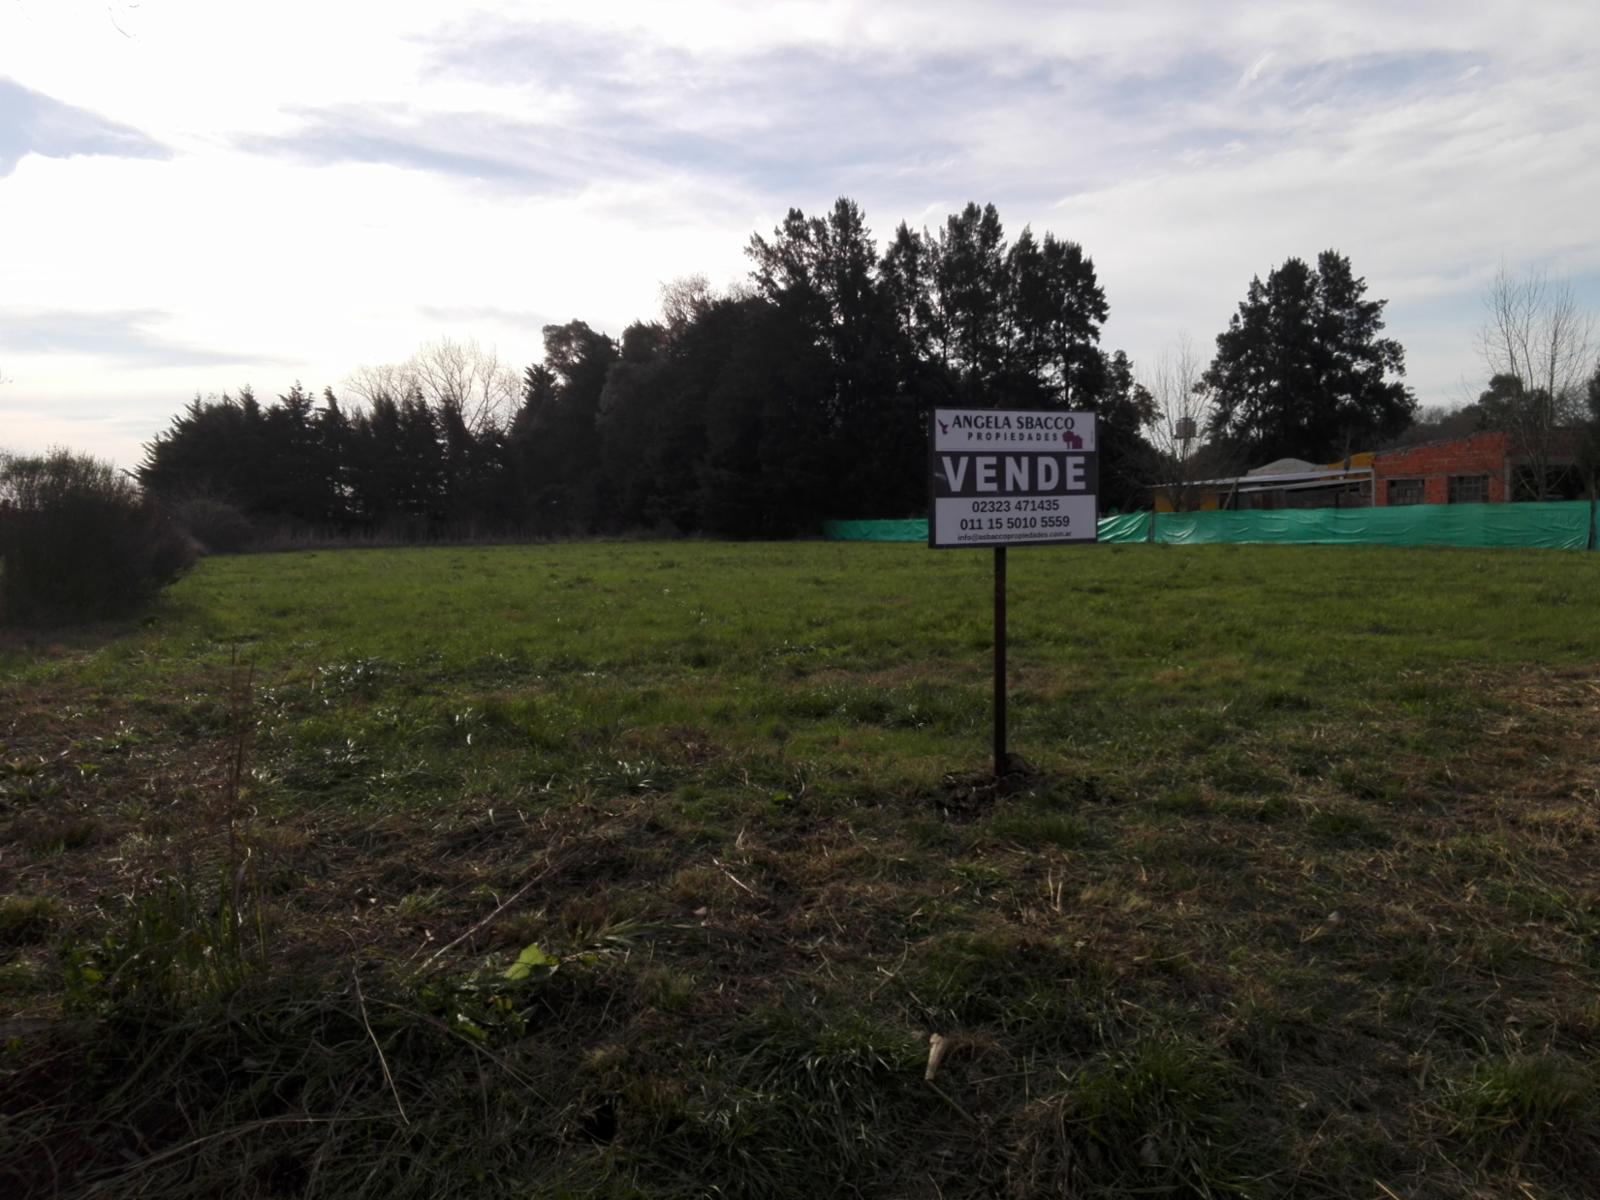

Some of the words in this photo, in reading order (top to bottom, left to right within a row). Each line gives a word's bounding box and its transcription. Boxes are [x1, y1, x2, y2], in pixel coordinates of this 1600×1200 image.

[951, 415, 1012, 429] ANGELA
[1016, 416, 1075, 430] SBACCO
[967, 431, 1058, 441] PROPIEDADES
[941, 456, 1087, 492] VENDE
[972, 501, 1011, 513] 02323
[1015, 500, 1060, 512] 471435
[960, 518, 983, 530] 011
[987, 518, 1003, 530] 15
[1007, 517, 1037, 529] 5010
[1041, 516, 1070, 528] 5559
